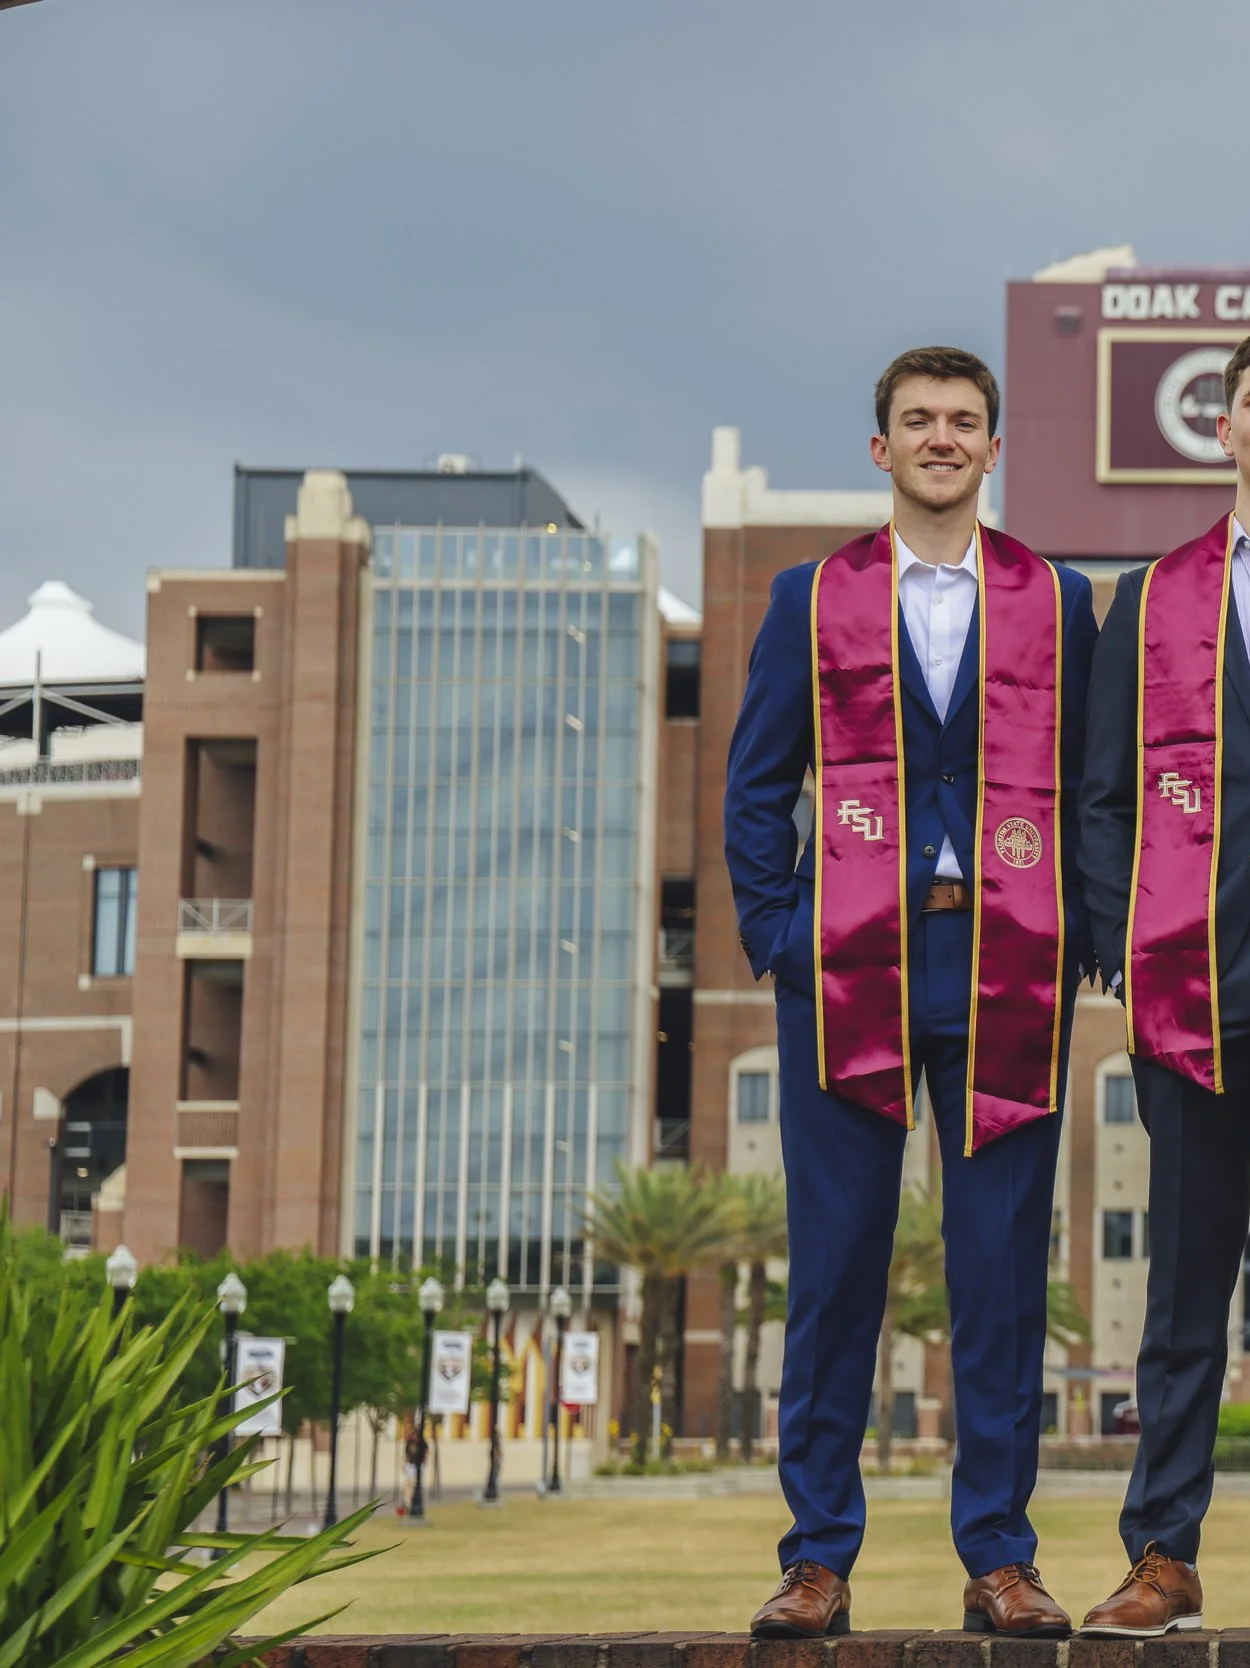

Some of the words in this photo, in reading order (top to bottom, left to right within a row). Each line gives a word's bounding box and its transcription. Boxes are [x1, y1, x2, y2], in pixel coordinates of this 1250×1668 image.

[1101, 284, 1200, 319] DOAK
[1157, 771, 1202, 814] FSU
[836, 799, 885, 841] FSU
[1006, 820, 1025, 828] STATE
